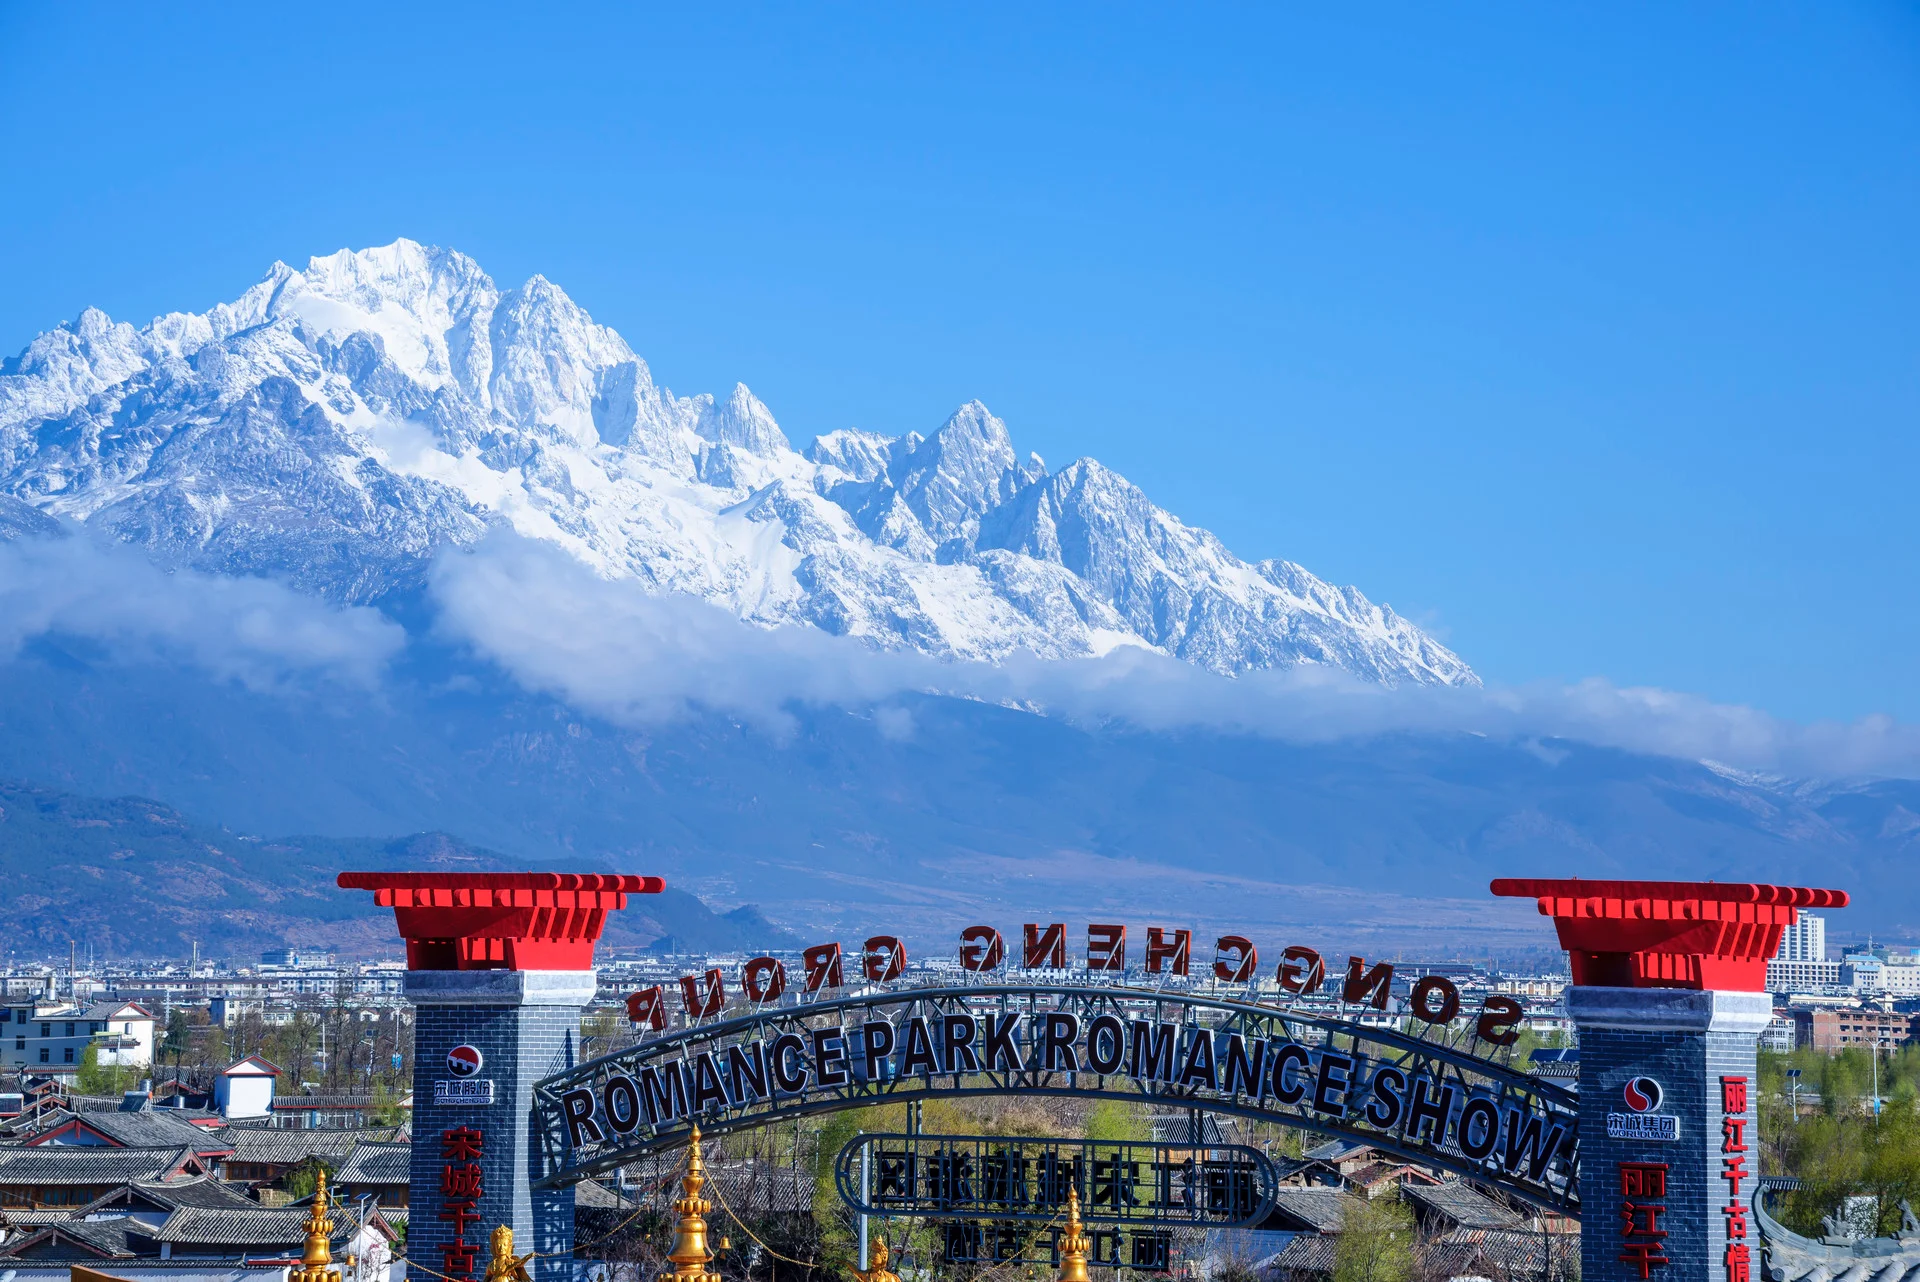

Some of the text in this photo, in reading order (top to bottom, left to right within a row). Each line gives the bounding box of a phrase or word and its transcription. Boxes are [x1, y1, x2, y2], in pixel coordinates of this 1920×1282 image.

[434, 1080, 492, 1096] 宋城股份
[560, 1011, 1567, 1183] ROMANCE PARK ROMANCE SHOW
[1607, 1113, 1676, 1132] 宋城集团
[1608, 1129, 1676, 1140] WORLDLAND
[439, 1126, 483, 1282] 宋城千古
[1618, 1162, 1669, 1279] 丽江千
[1721, 1076, 1751, 1282] 丽江千古情
